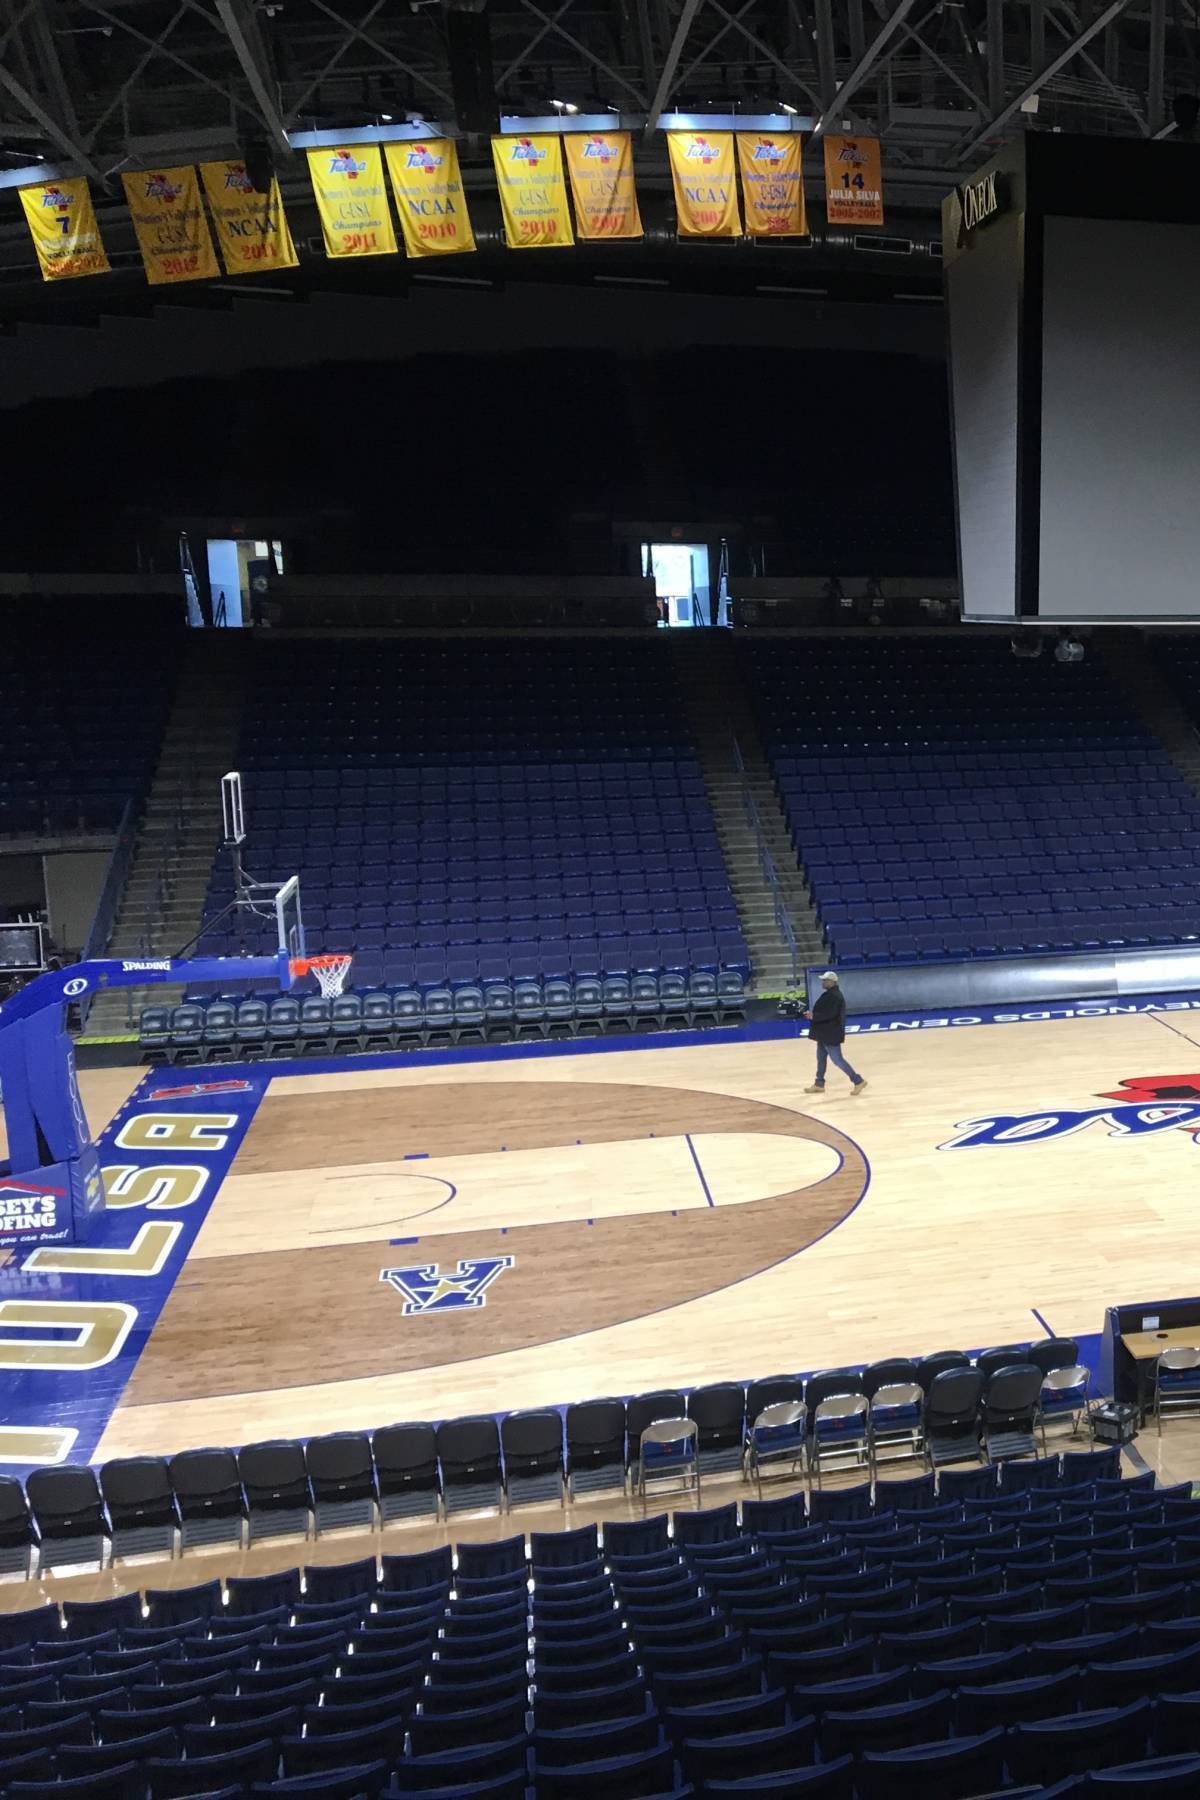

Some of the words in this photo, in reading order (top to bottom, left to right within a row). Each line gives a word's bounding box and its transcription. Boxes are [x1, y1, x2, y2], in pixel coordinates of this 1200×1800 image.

[582, 143, 619, 158] Tulsa
[841, 172, 865, 190] 14
[684, 187, 729, 203] NCAA
[829, 189, 855, 200] JULIA
[856, 190, 881, 201] SILVA
[964, 170, 998, 230] ONEOK
[407, 197, 457, 216] NCAA
[55, 216, 71, 234] 7
[227, 217, 278, 238] NCAA
[418, 223, 457, 240] 2010
[520, 218, 557, 235] 2010
[342, 232, 378, 252] 2011
[239, 242, 278, 261] 2011
[160, 256, 199, 275] 2012
[122, 960, 171, 972] SPALDING
[40, 1228, 70, 1241] trust!
